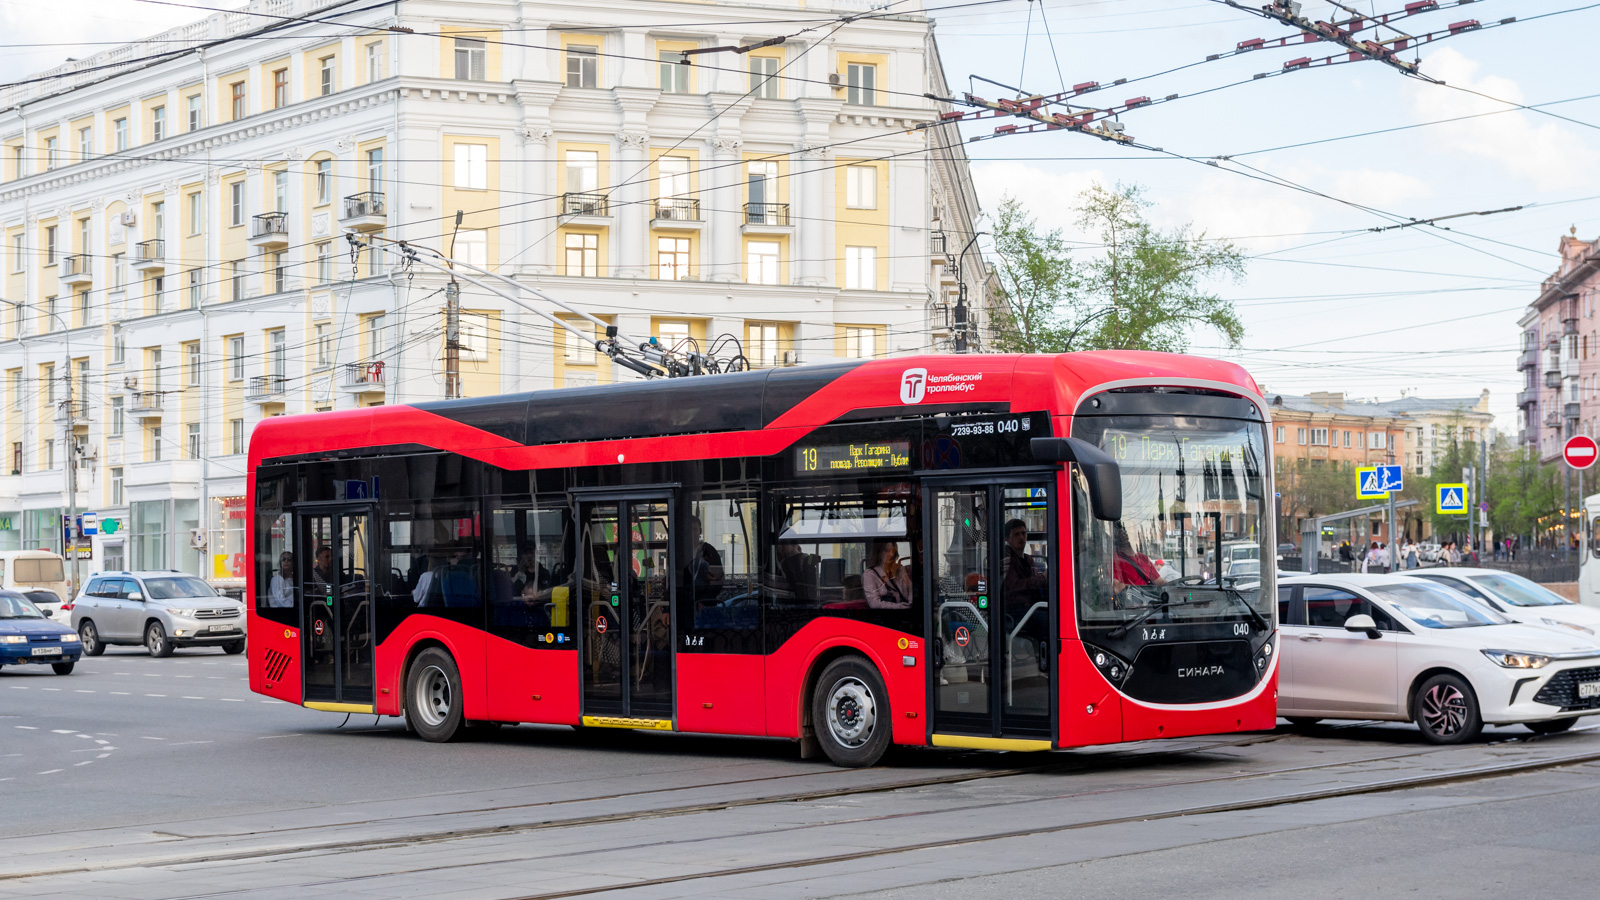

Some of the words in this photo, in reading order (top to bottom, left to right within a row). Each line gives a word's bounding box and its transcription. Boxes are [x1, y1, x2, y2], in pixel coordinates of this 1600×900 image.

[927, 372, 983, 383] Челябинский
[926, 382, 975, 394] троллейбус
[957, 425, 994, 436] 239-93-88
[997, 419, 1019, 433] 040
[849, 444, 863, 456] Парк
[864, 443, 891, 456] Гагарина
[1111, 435, 1127, 460] 19
[1141, 436, 1175, 461] Парк
[1182, 437, 1244, 462] Гагарина
[802, 448, 817, 471] 19
[1233, 622, 1250, 636] 040
[1177, 665, 1225, 678] СИНАРА
